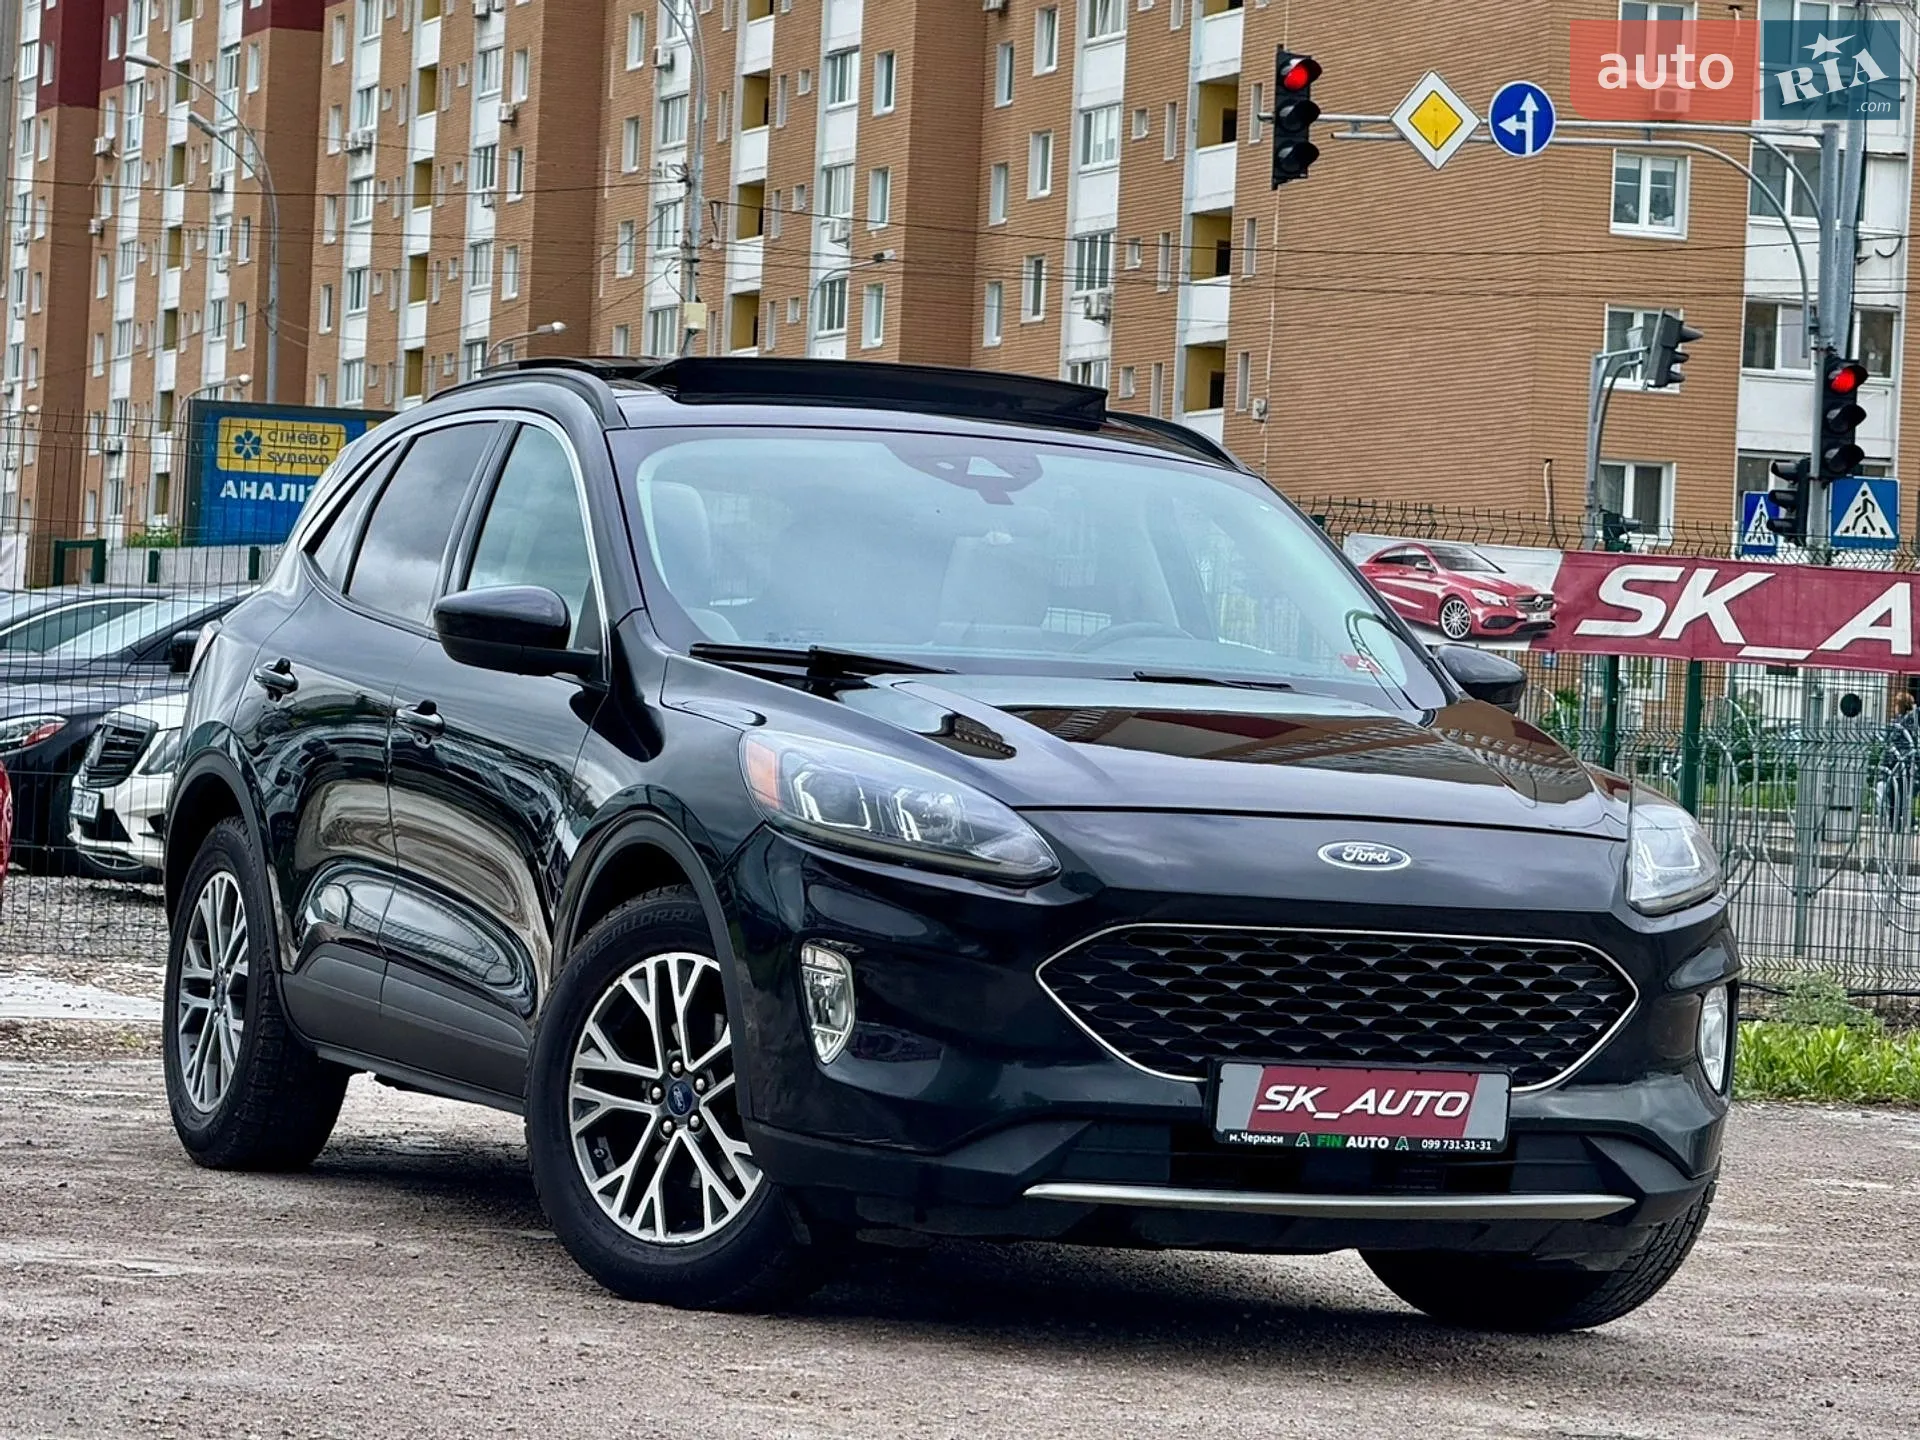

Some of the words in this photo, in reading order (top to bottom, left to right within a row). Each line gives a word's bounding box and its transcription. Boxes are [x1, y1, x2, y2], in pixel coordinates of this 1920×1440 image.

[267, 451, 331, 466] synevo
[1342, 845, 1391, 863] Ford
[1257, 1085, 1471, 1119] SK_AUTO
[1317, 1134, 1343, 1147] FIN
[1346, 1136, 1389, 1149] AUTO
[1421, 1139, 1440, 1149] 099
[1443, 1140, 1492, 1151] 731-31-31
